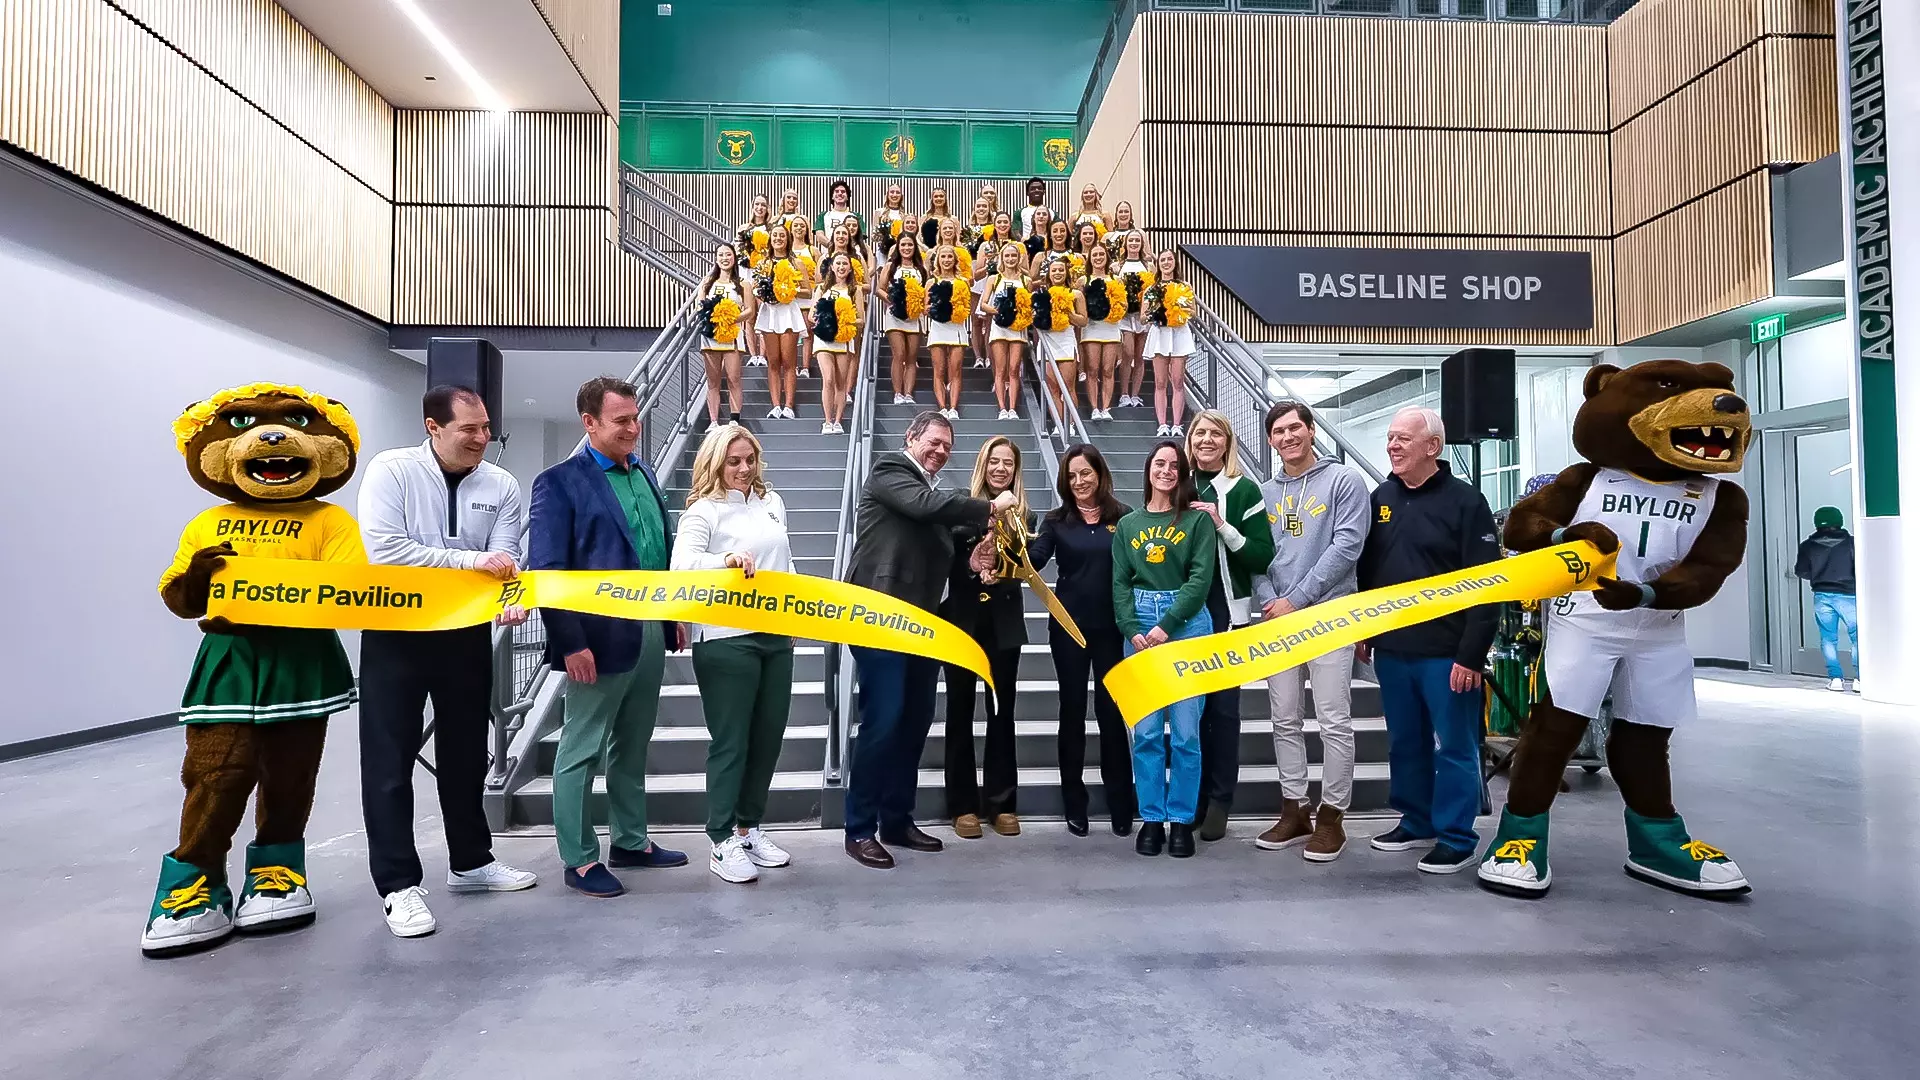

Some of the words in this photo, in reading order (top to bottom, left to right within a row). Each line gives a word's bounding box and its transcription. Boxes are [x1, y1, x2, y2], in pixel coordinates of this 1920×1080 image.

[1855, 175, 1893, 361] ACADEMIC
[1298, 272, 1447, 299] BASELINE
[1462, 275, 1542, 300] SHOP
[1757, 317, 1780, 341] EXIT
[471, 502, 498, 513] BAYLOR
[1267, 495, 1327, 525] BYOR
[1601, 493, 1697, 525] BAYLOR
[216, 518, 304, 540] BAYLOR
[1130, 525, 1187, 550] BAYLOR
[1637, 520, 1651, 558] 1
[231, 579, 312, 604] Foster
[317, 584, 423, 608] Pavilion
[594, 582, 649, 602] Paul
[650, 587, 667, 602] &
[671, 584, 778, 612] Alejandra
[783, 594, 847, 620] Foster
[850, 603, 935, 639] Pavilion
[1173, 652, 1224, 677] Paul
[1225, 650, 1245, 666] &
[1249, 615, 1351, 662] Alejandra
[1348, 594, 1420, 623] Foster
[1419, 572, 1510, 601] Pavilion
